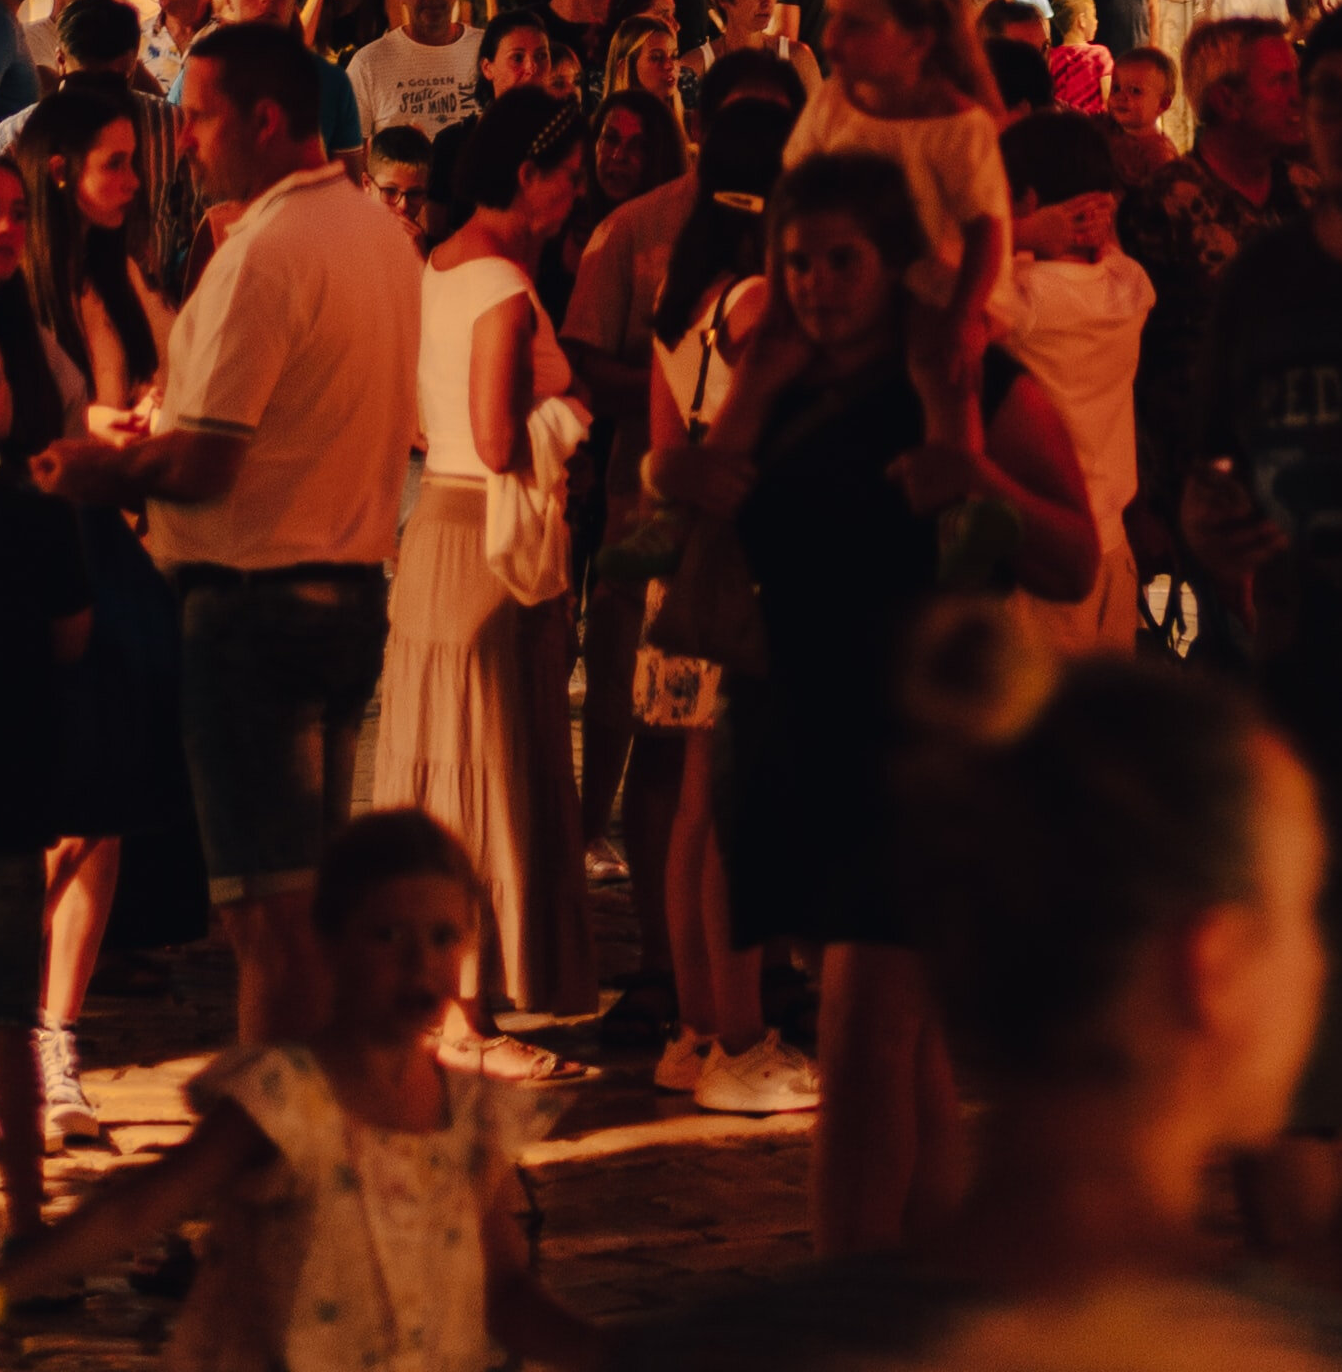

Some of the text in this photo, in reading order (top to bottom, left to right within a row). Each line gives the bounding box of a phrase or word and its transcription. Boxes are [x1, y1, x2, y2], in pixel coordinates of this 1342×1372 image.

[408, 76, 455, 87] GOLDEN
[411, 92, 457, 114] OF MIND
